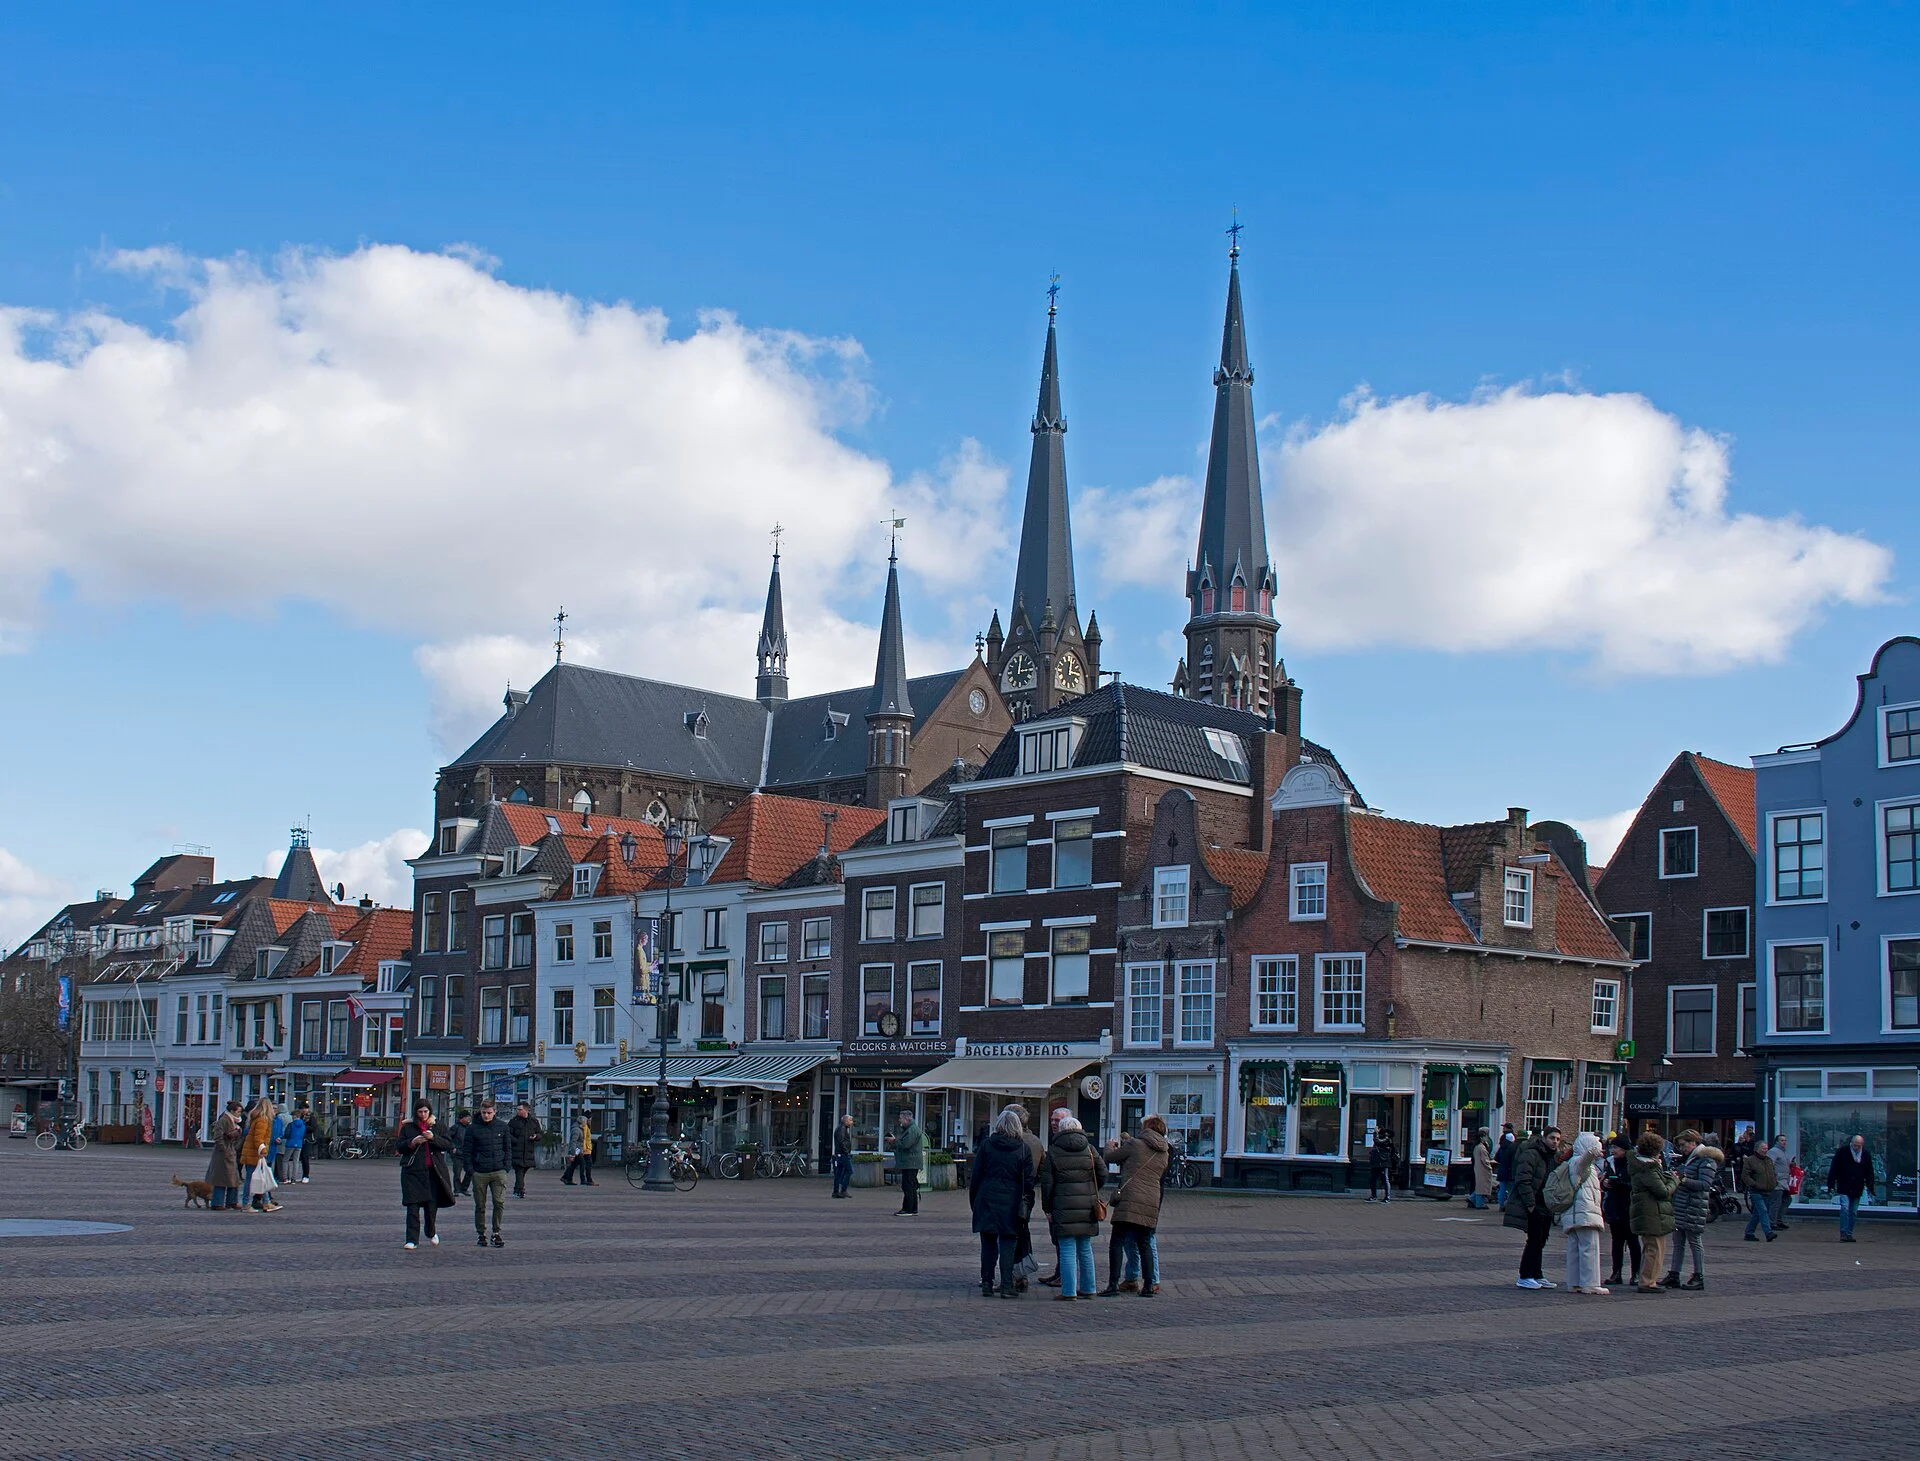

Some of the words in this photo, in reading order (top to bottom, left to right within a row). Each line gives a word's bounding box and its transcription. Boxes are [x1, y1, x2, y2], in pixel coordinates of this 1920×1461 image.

[849, 1042, 887, 1052] CLOCKS
[889, 1042, 897, 1051] &
[900, 1041, 947, 1051] WATCHES
[1312, 1084, 1334, 1093] Open
[1301, 1097, 1338, 1107] SUBWAY
[1430, 1157, 1445, 1165] BIG
